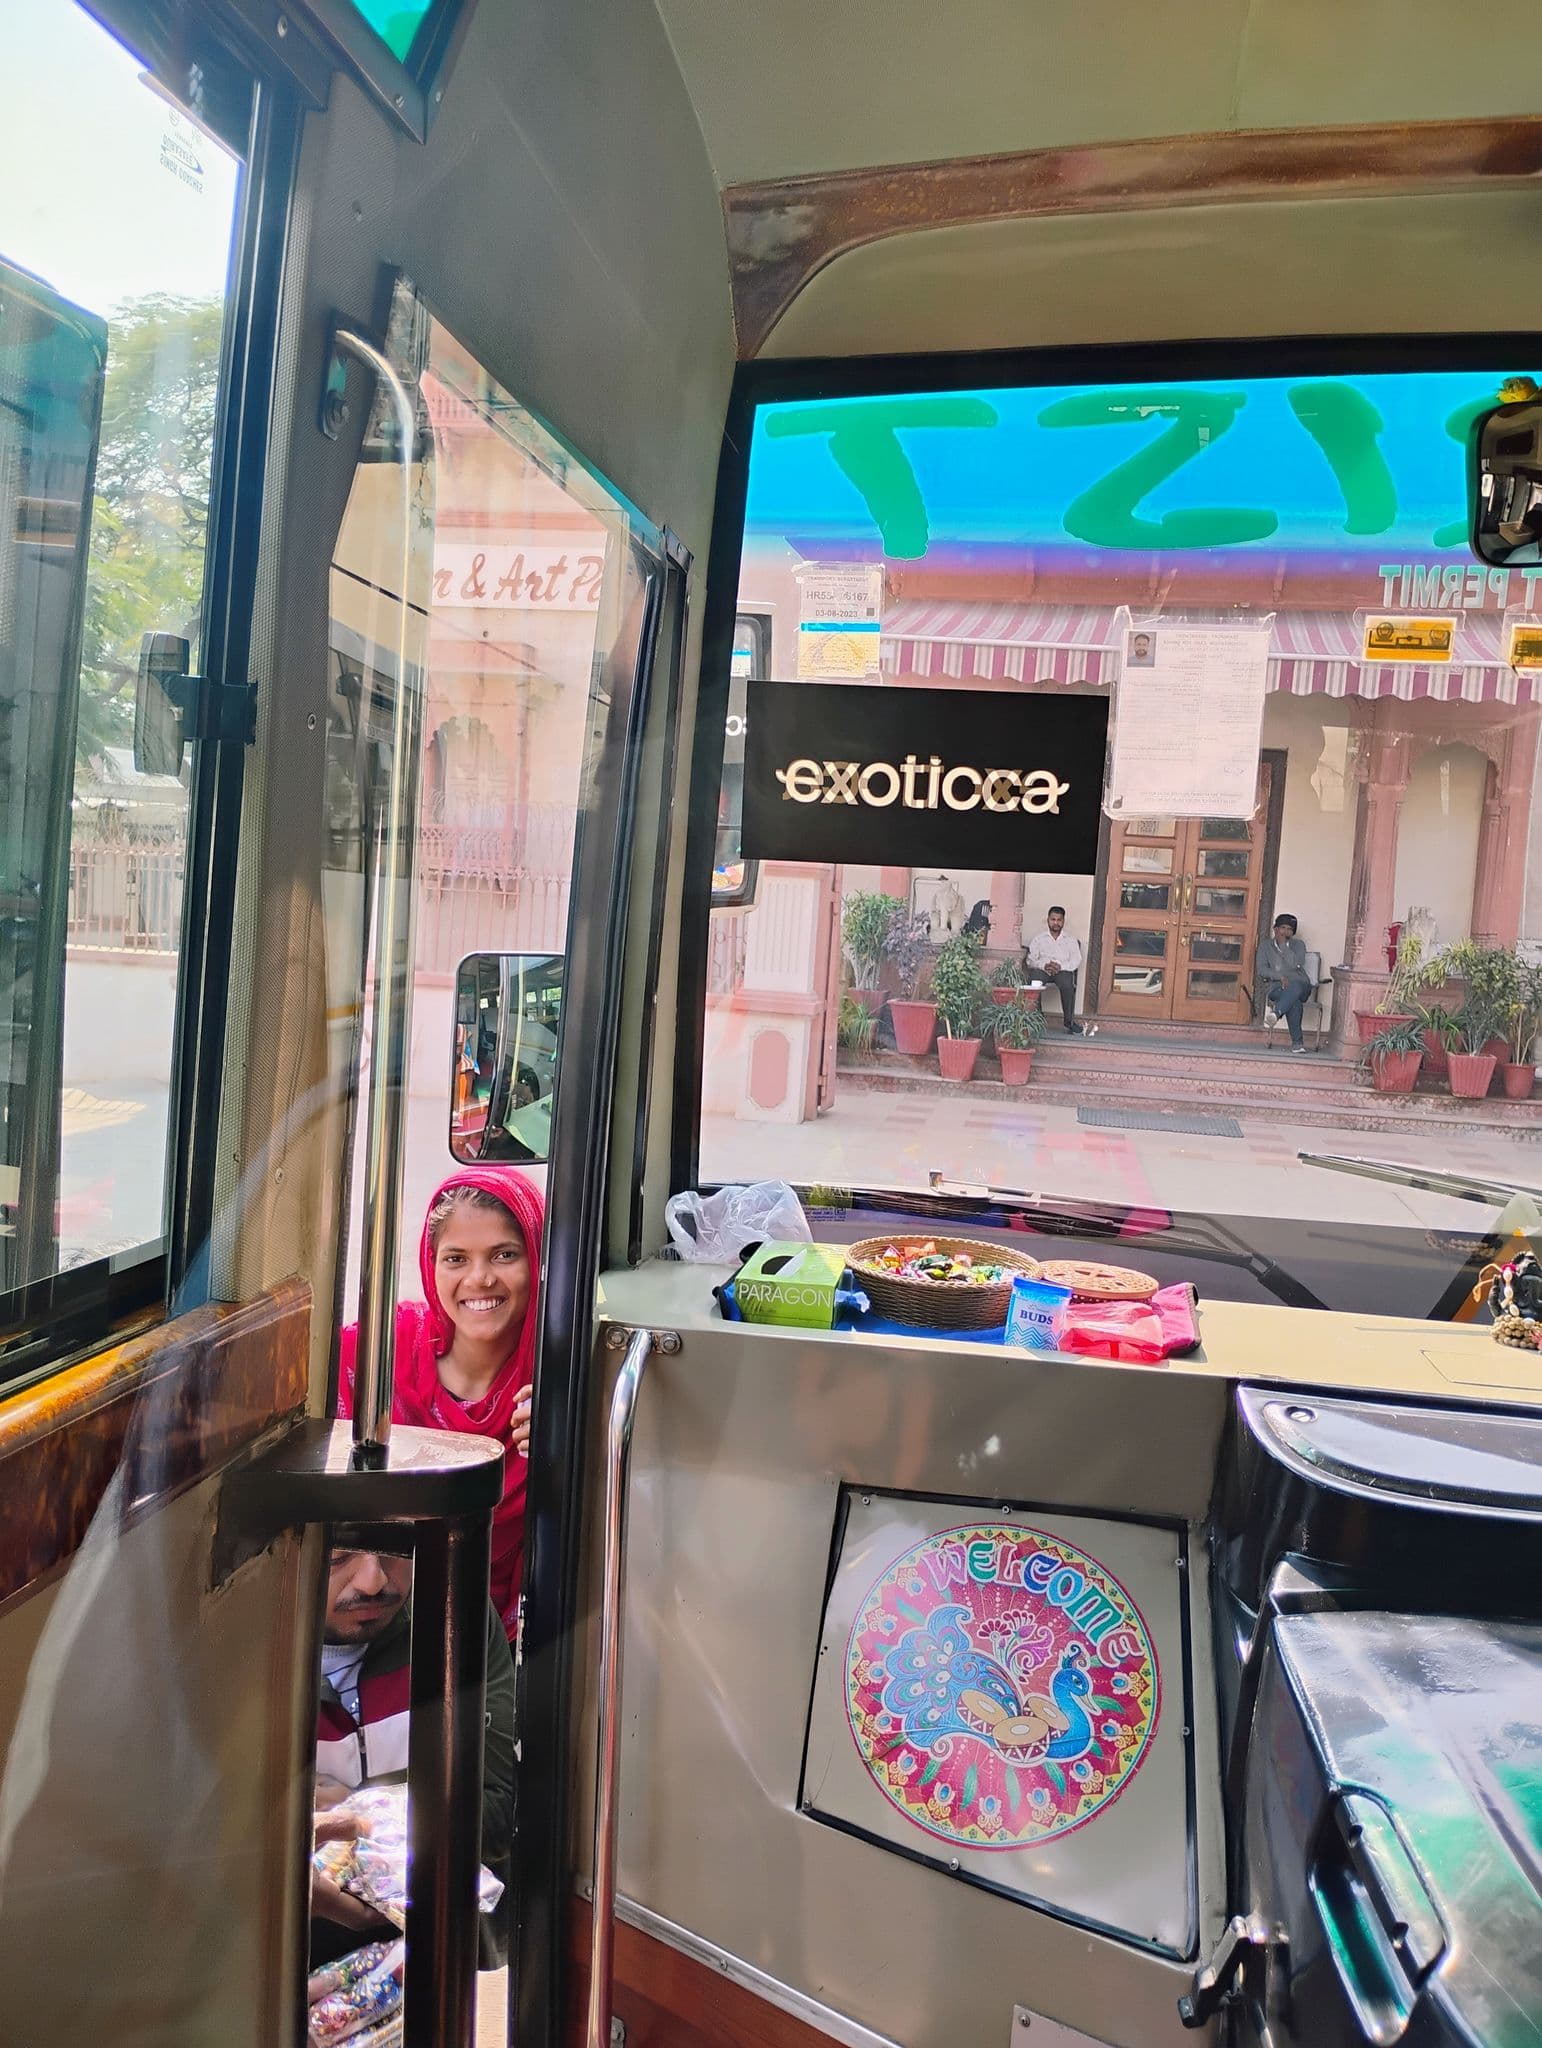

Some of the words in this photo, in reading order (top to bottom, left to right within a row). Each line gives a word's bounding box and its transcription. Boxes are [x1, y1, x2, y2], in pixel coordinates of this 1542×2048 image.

[460, 552, 487, 600] &
[493, 552, 569, 603] Art
[775, 753, 1070, 815] exoticca
[738, 1282, 832, 1308] PARAGON
[1020, 1309, 1054, 1325] BUDS
[920, 1540, 1145, 1667] WELCOME
